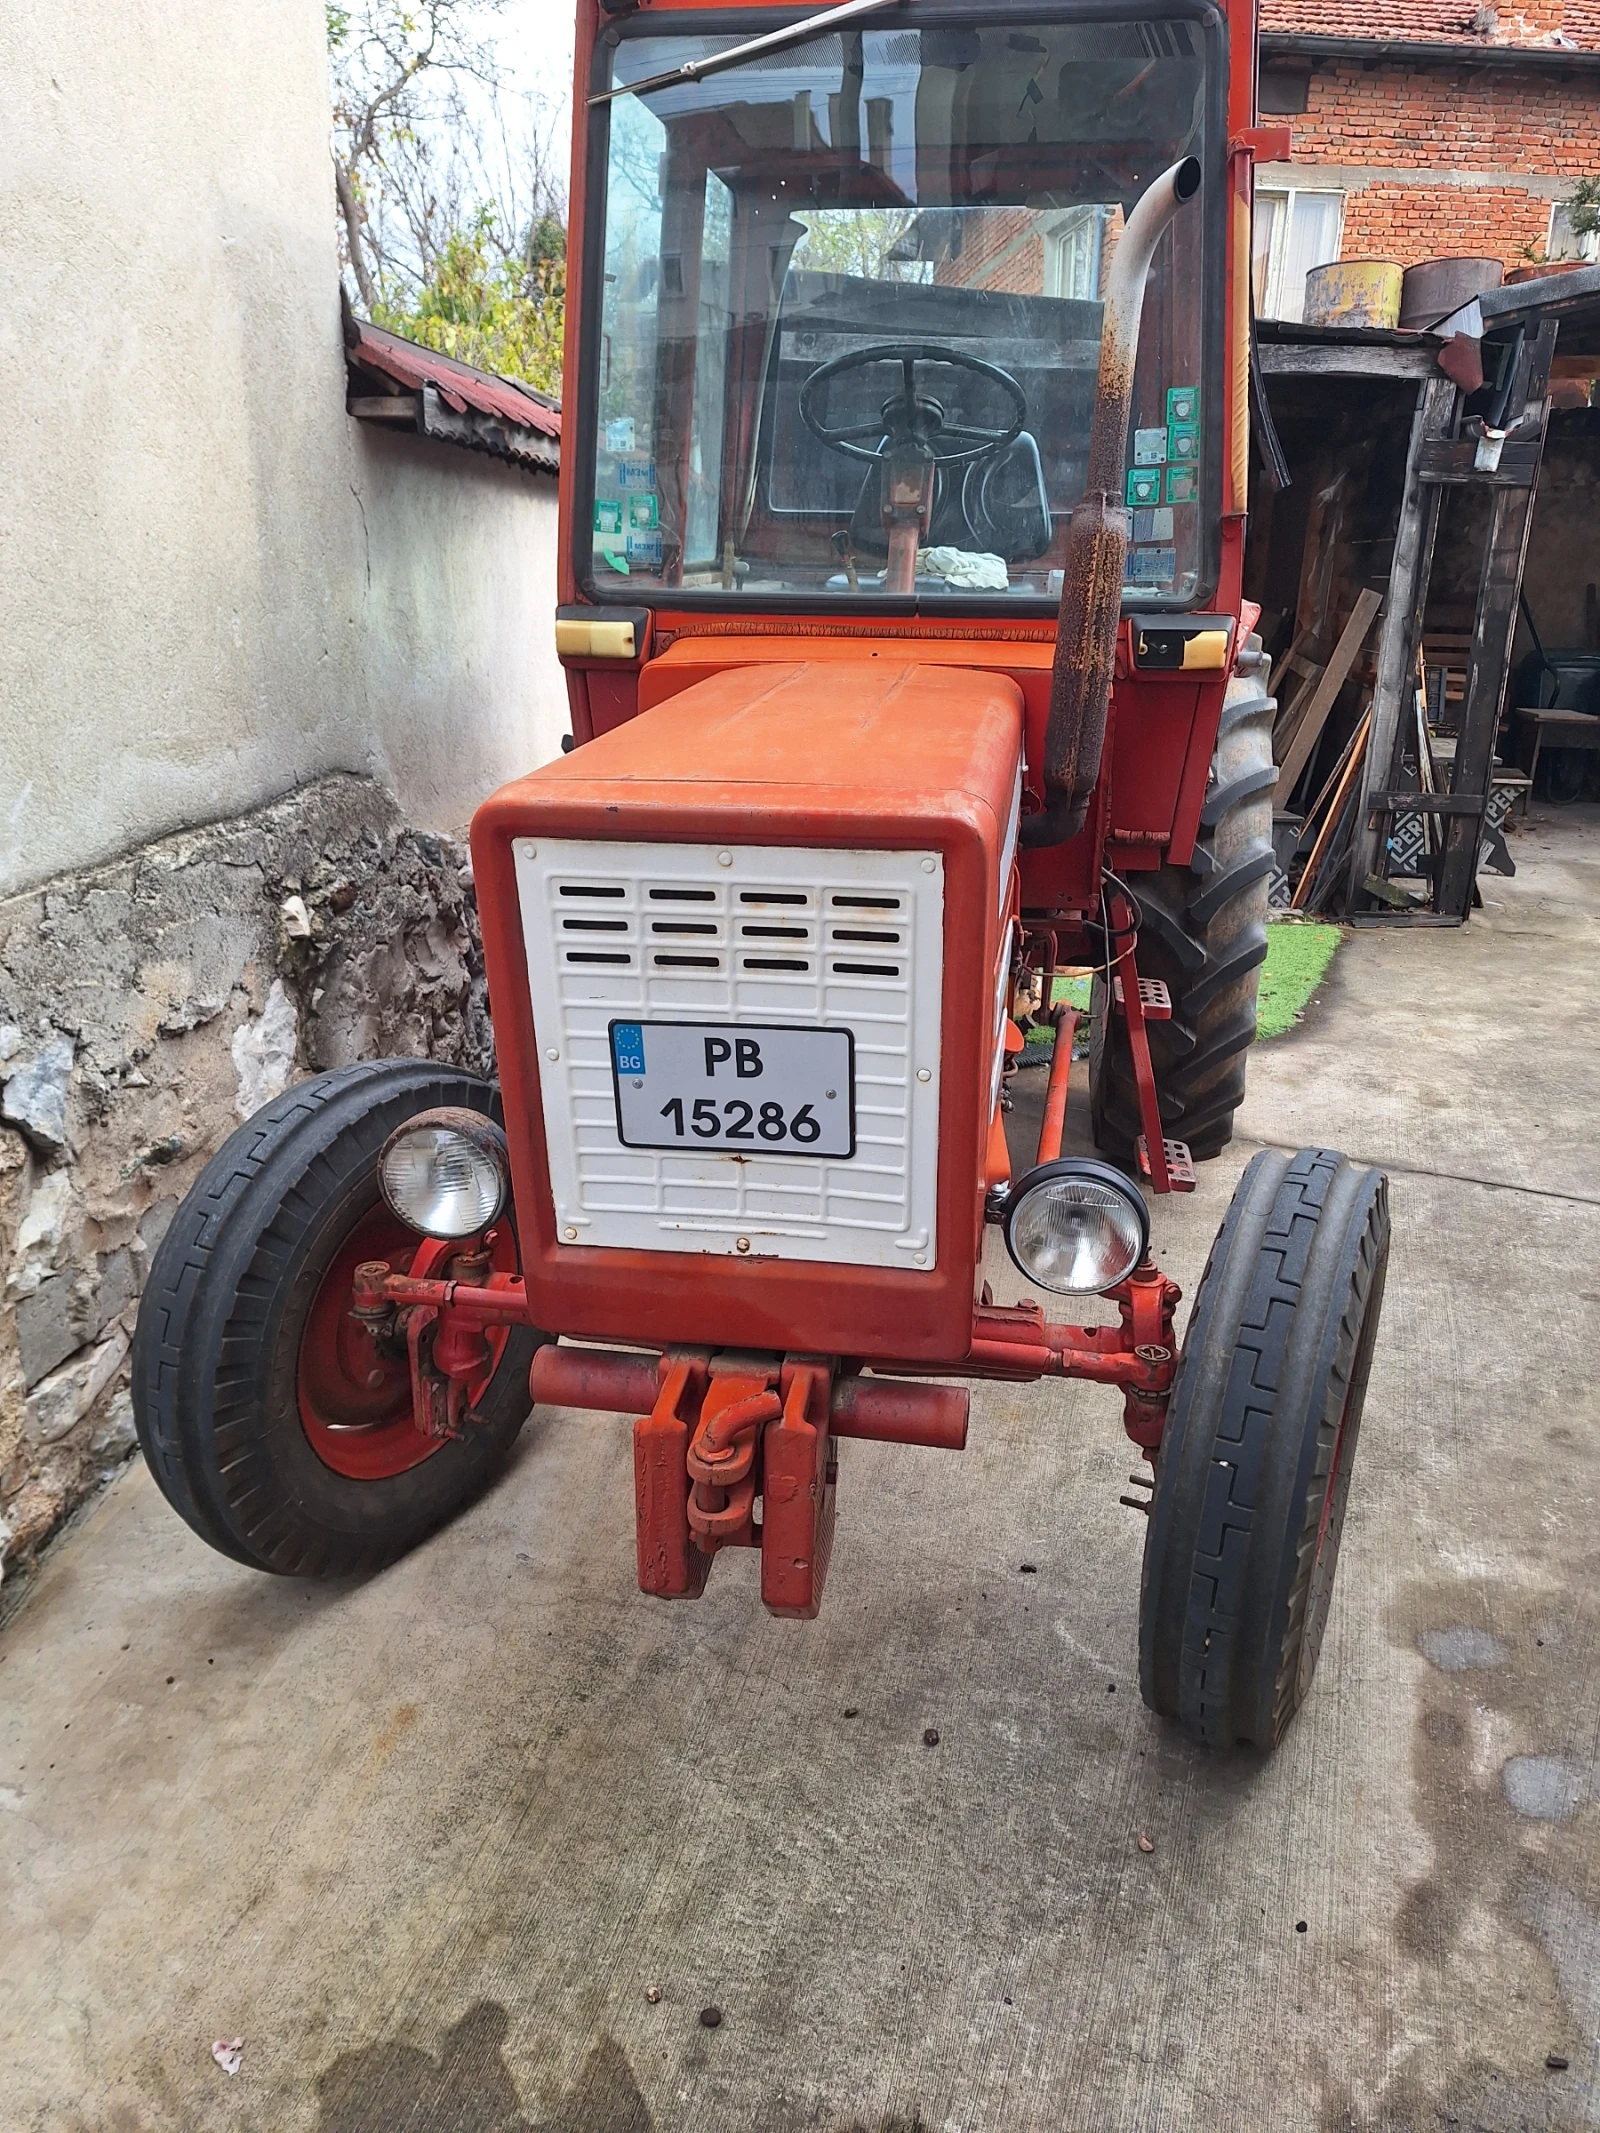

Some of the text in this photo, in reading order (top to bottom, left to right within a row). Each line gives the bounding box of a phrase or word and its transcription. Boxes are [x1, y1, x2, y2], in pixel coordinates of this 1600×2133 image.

[619, 1055, 641, 1069] BG
[703, 1036, 764, 1078] PB
[659, 1097, 821, 1143] 15286
